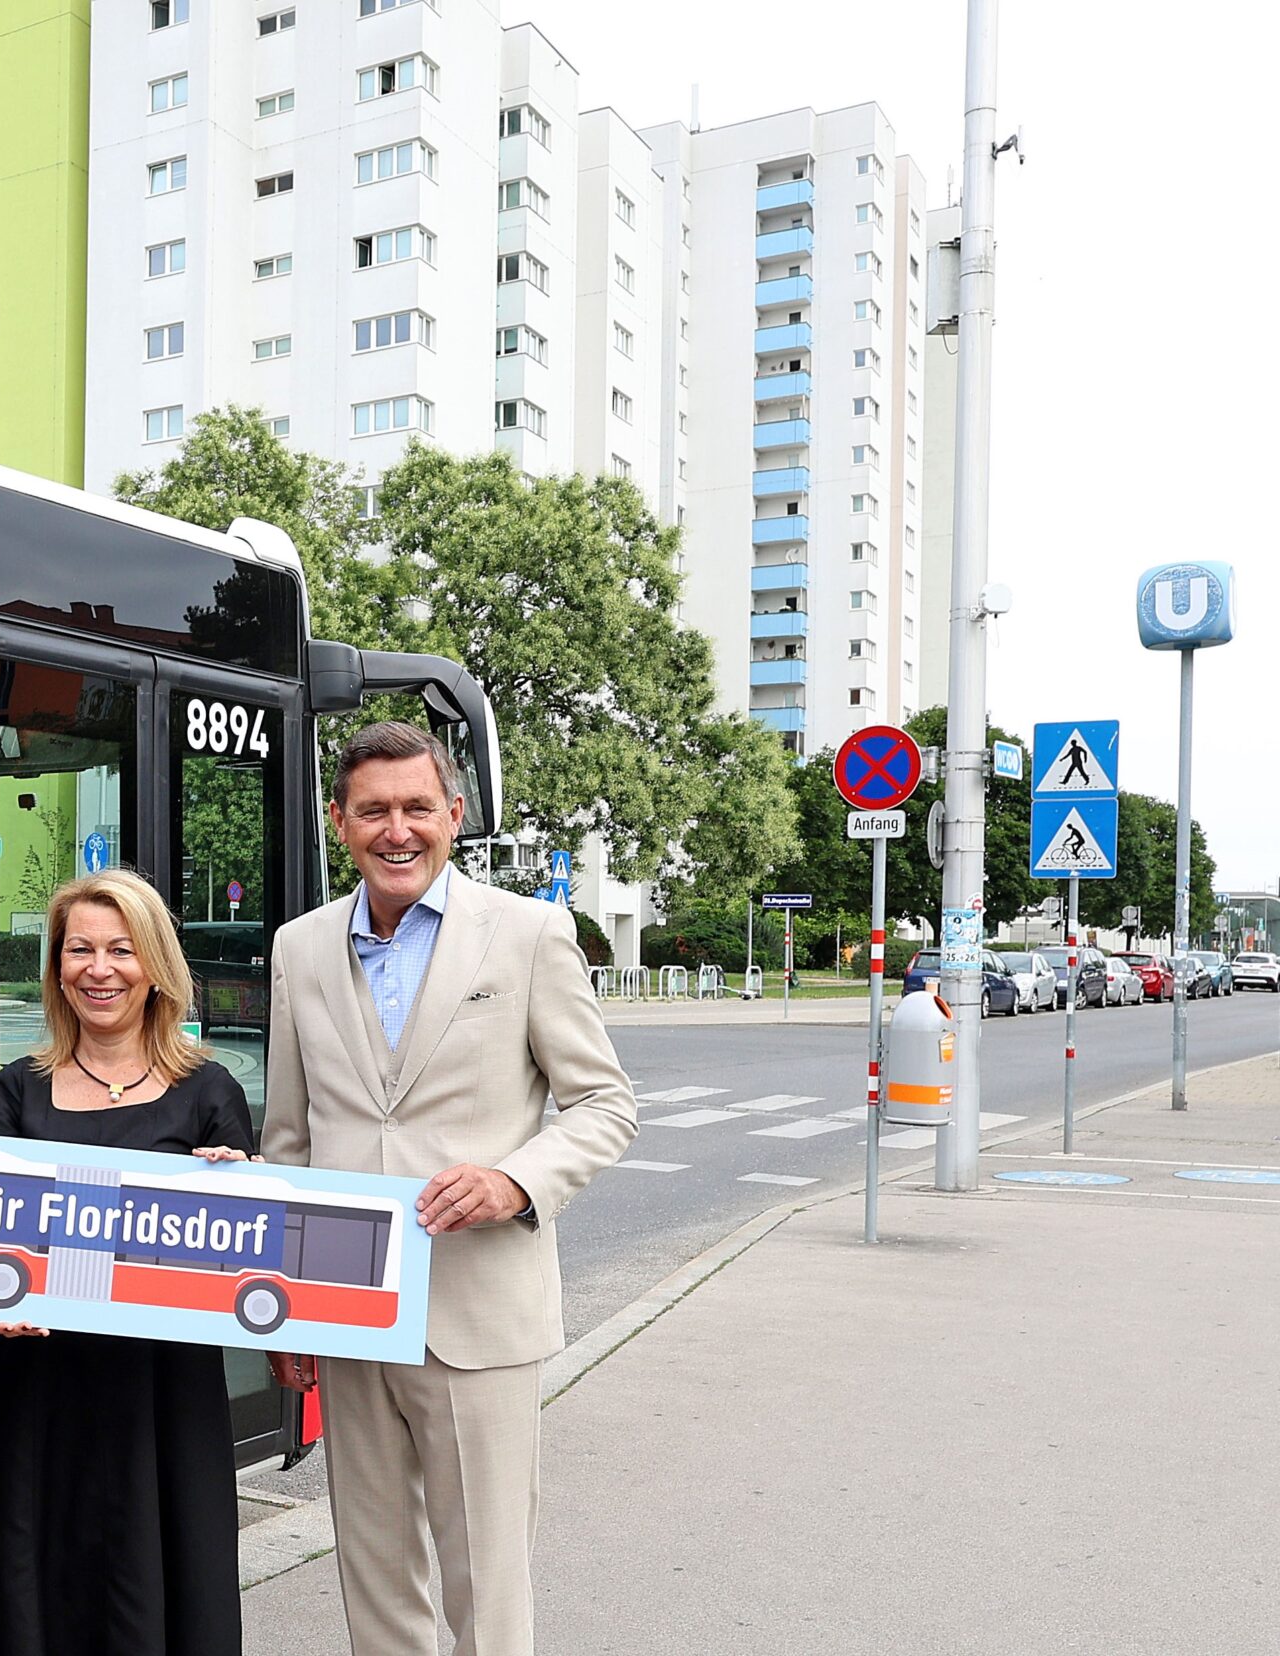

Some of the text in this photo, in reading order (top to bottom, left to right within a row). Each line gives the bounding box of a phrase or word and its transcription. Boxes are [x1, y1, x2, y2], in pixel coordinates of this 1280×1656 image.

[1155, 576, 1208, 631] U
[186, 698, 270, 758] 8894
[853, 817, 899, 833] Anfang
[38, 1192, 269, 1256] Floridsdorf
